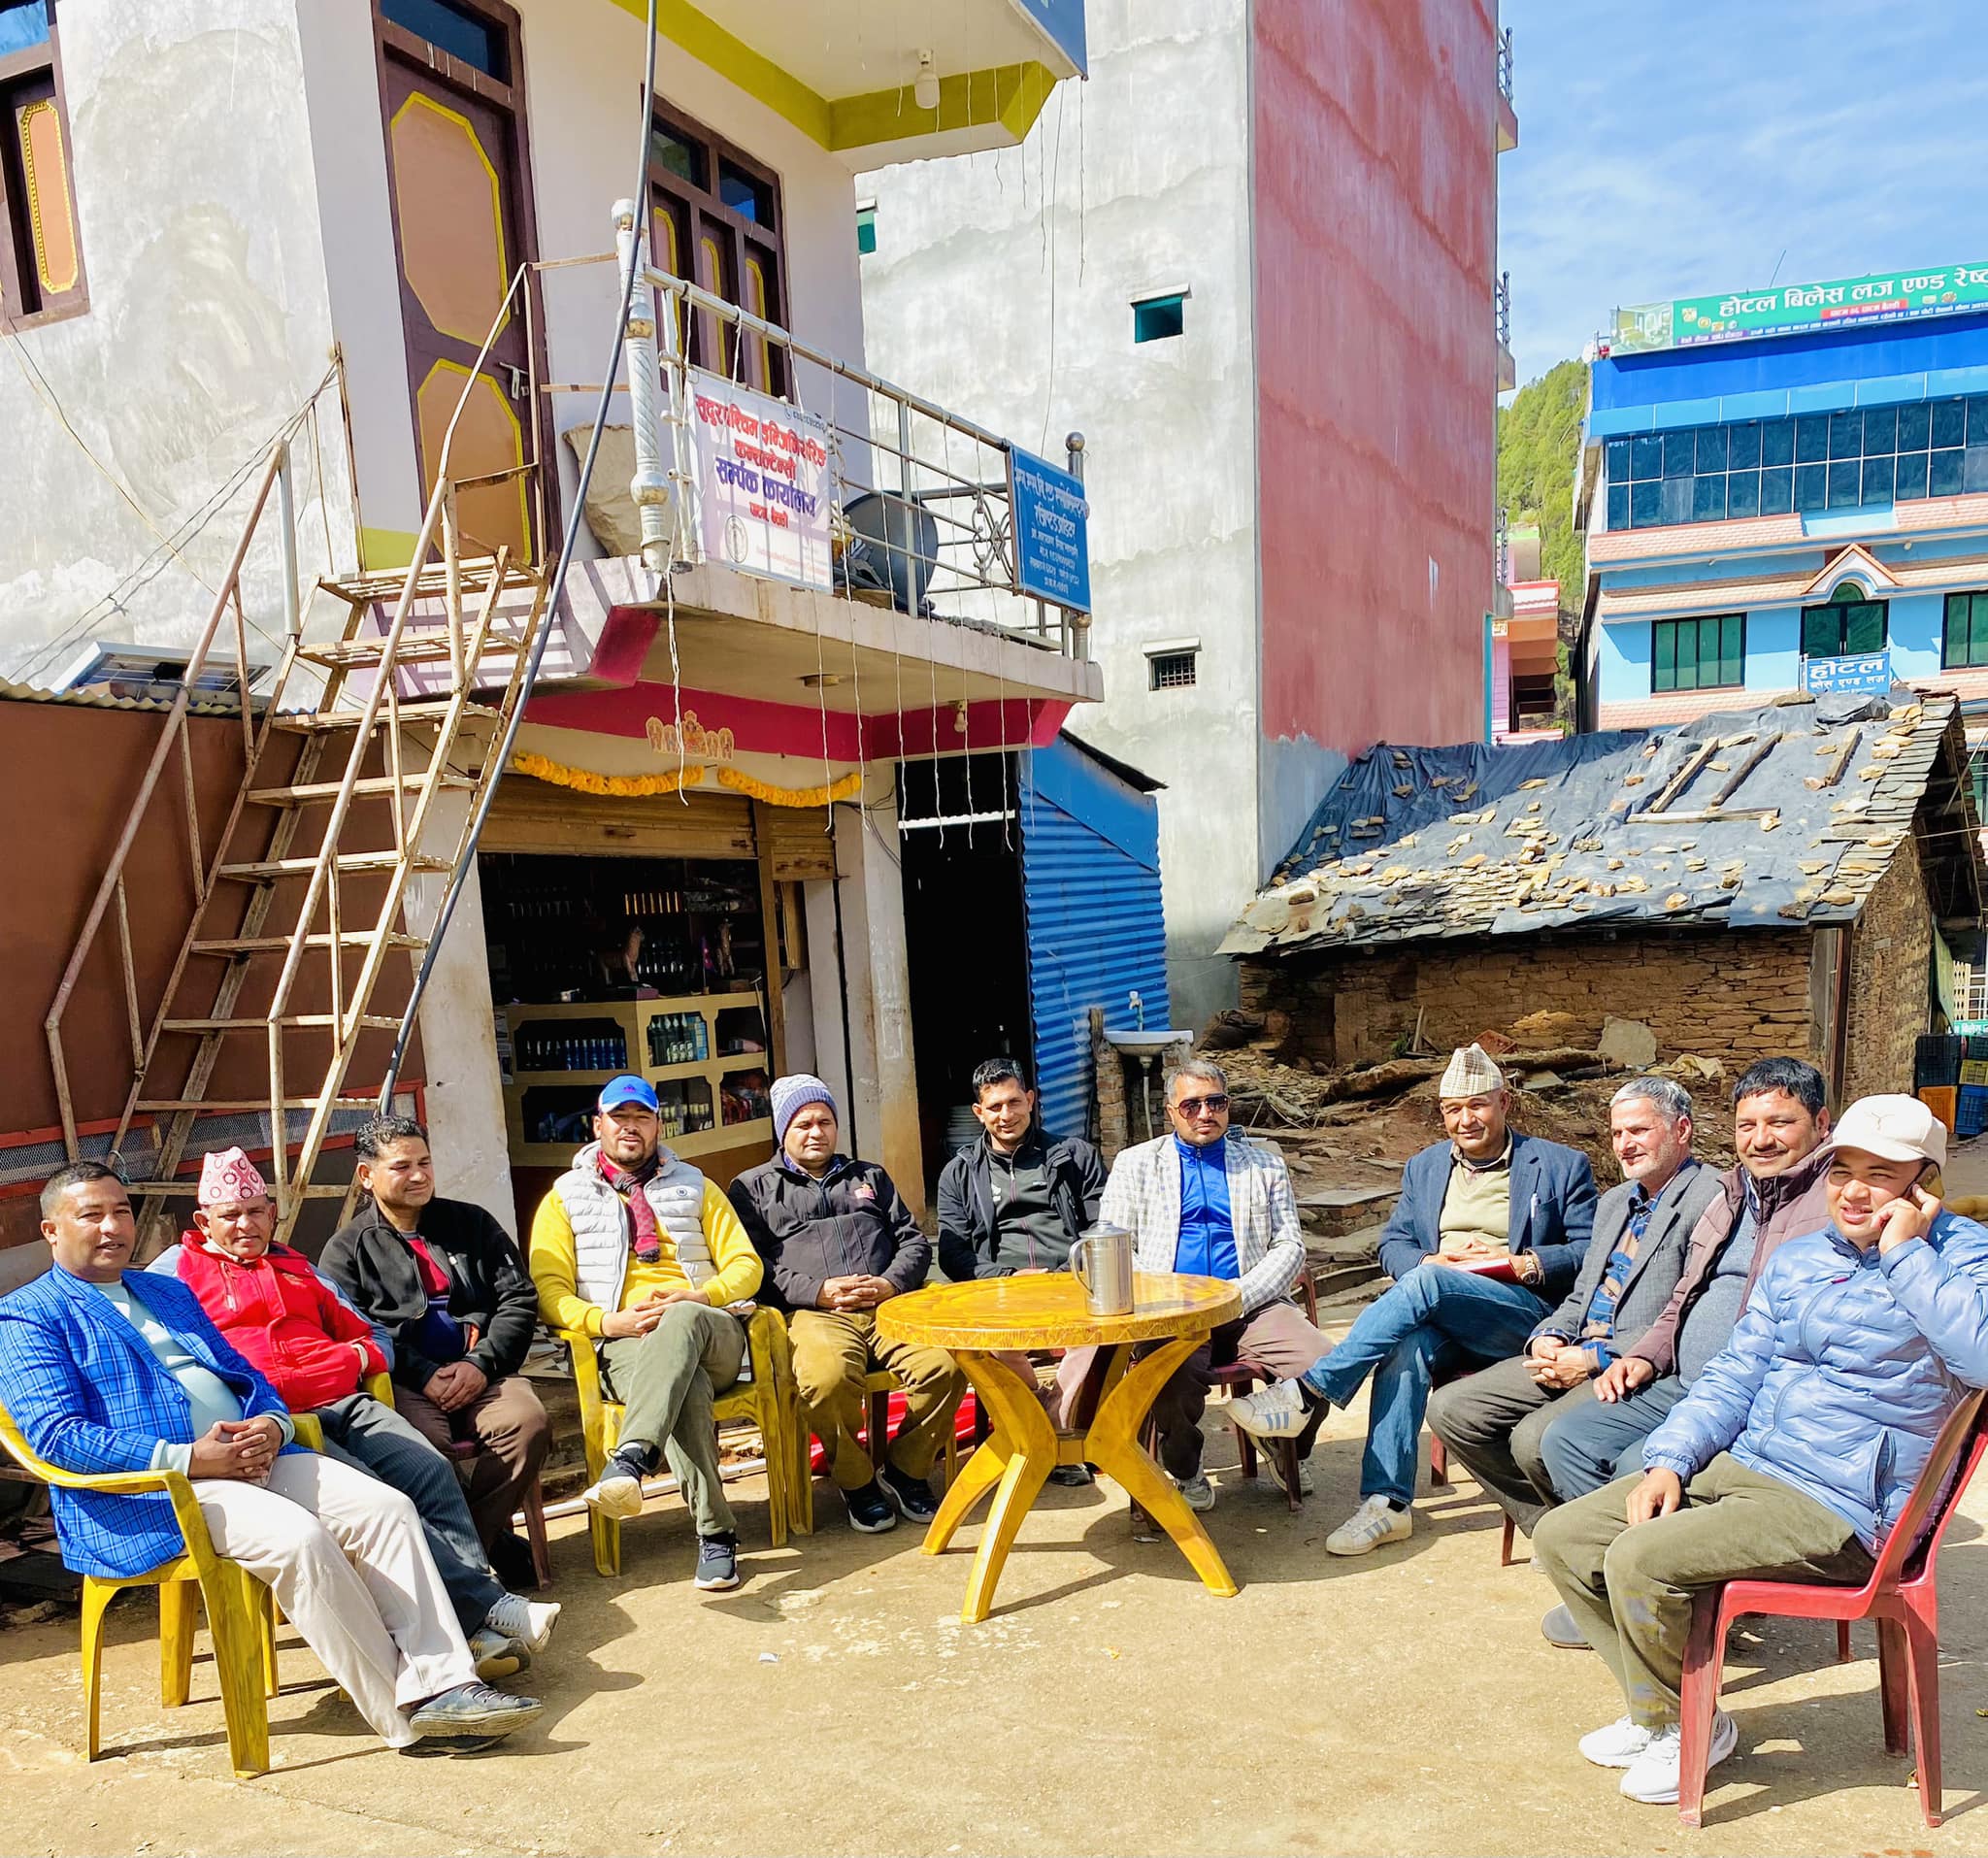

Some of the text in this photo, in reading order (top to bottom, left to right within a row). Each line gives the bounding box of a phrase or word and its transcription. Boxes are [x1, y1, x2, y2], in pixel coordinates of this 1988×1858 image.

[1719, 294, 1777, 317] होटल
[1784, 285, 1845, 309] बिलेस
[1851, 280, 1895, 301] लज
[1901, 273, 1947, 293] एण्ड
[1808, 659, 1885, 679] होटल
